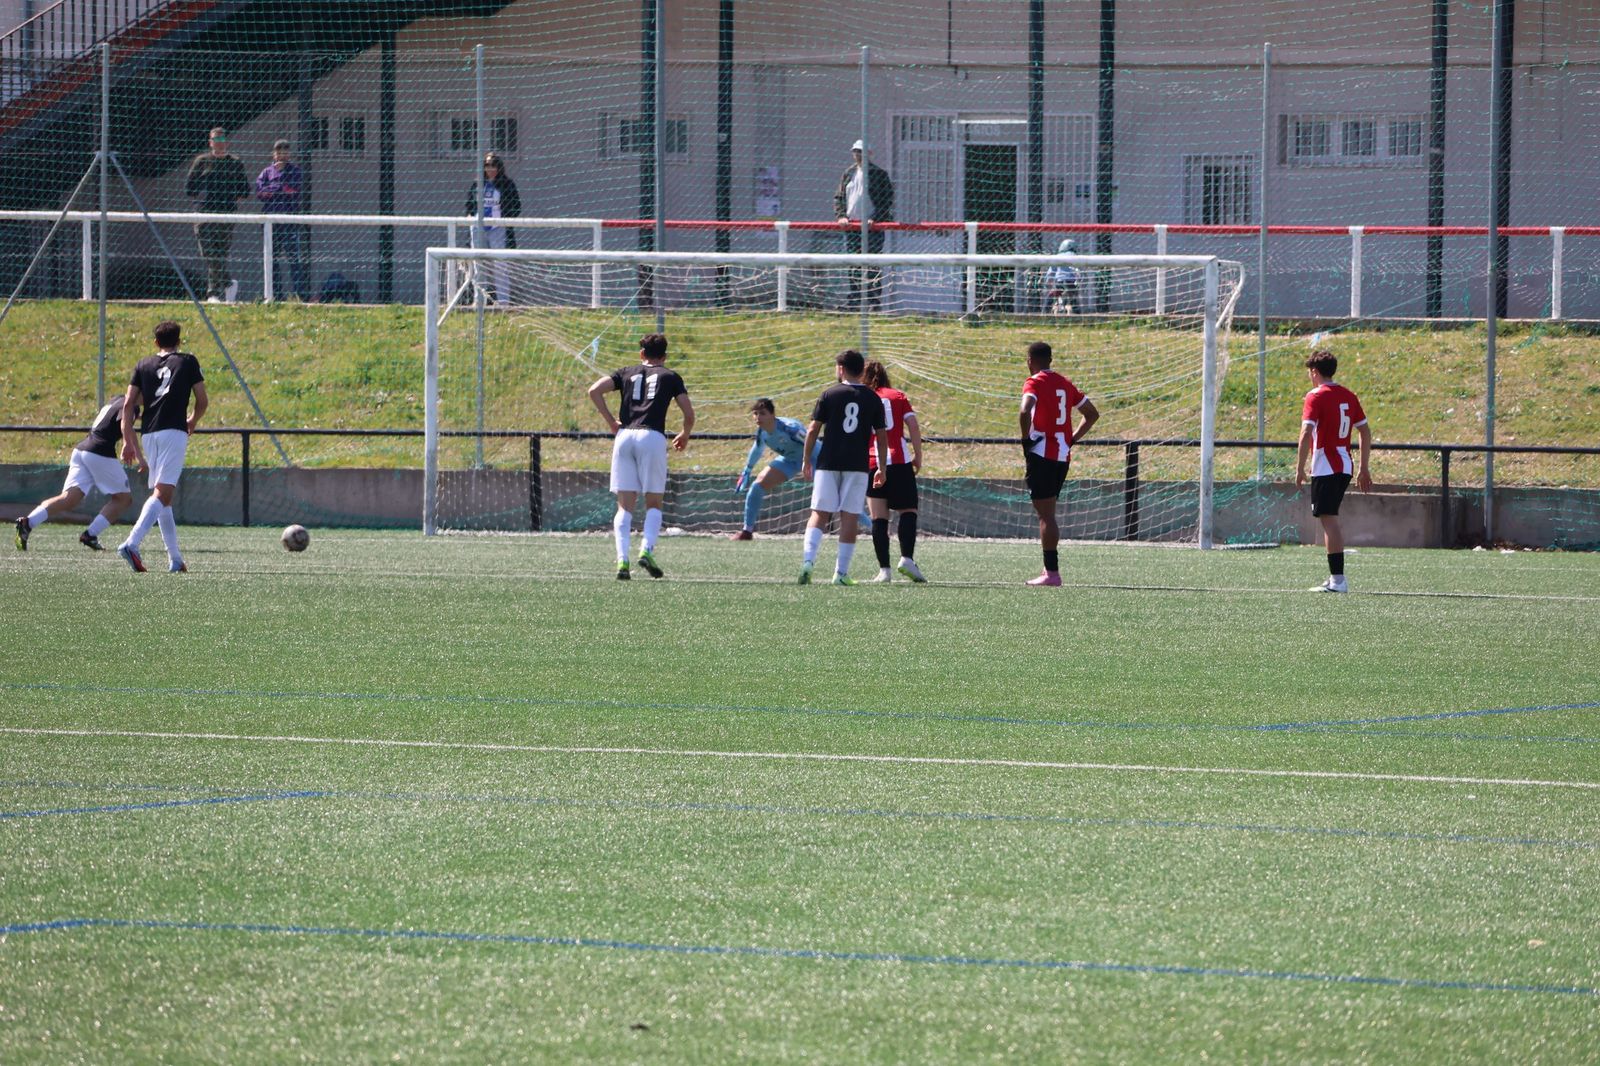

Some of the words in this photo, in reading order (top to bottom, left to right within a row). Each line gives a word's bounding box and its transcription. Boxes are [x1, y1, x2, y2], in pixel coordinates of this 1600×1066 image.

[153, 366, 172, 399] 2
[630, 373, 658, 401] 11
[842, 402, 860, 434] 8
[1055, 389, 1067, 426] 3
[1338, 402, 1351, 439] 6
